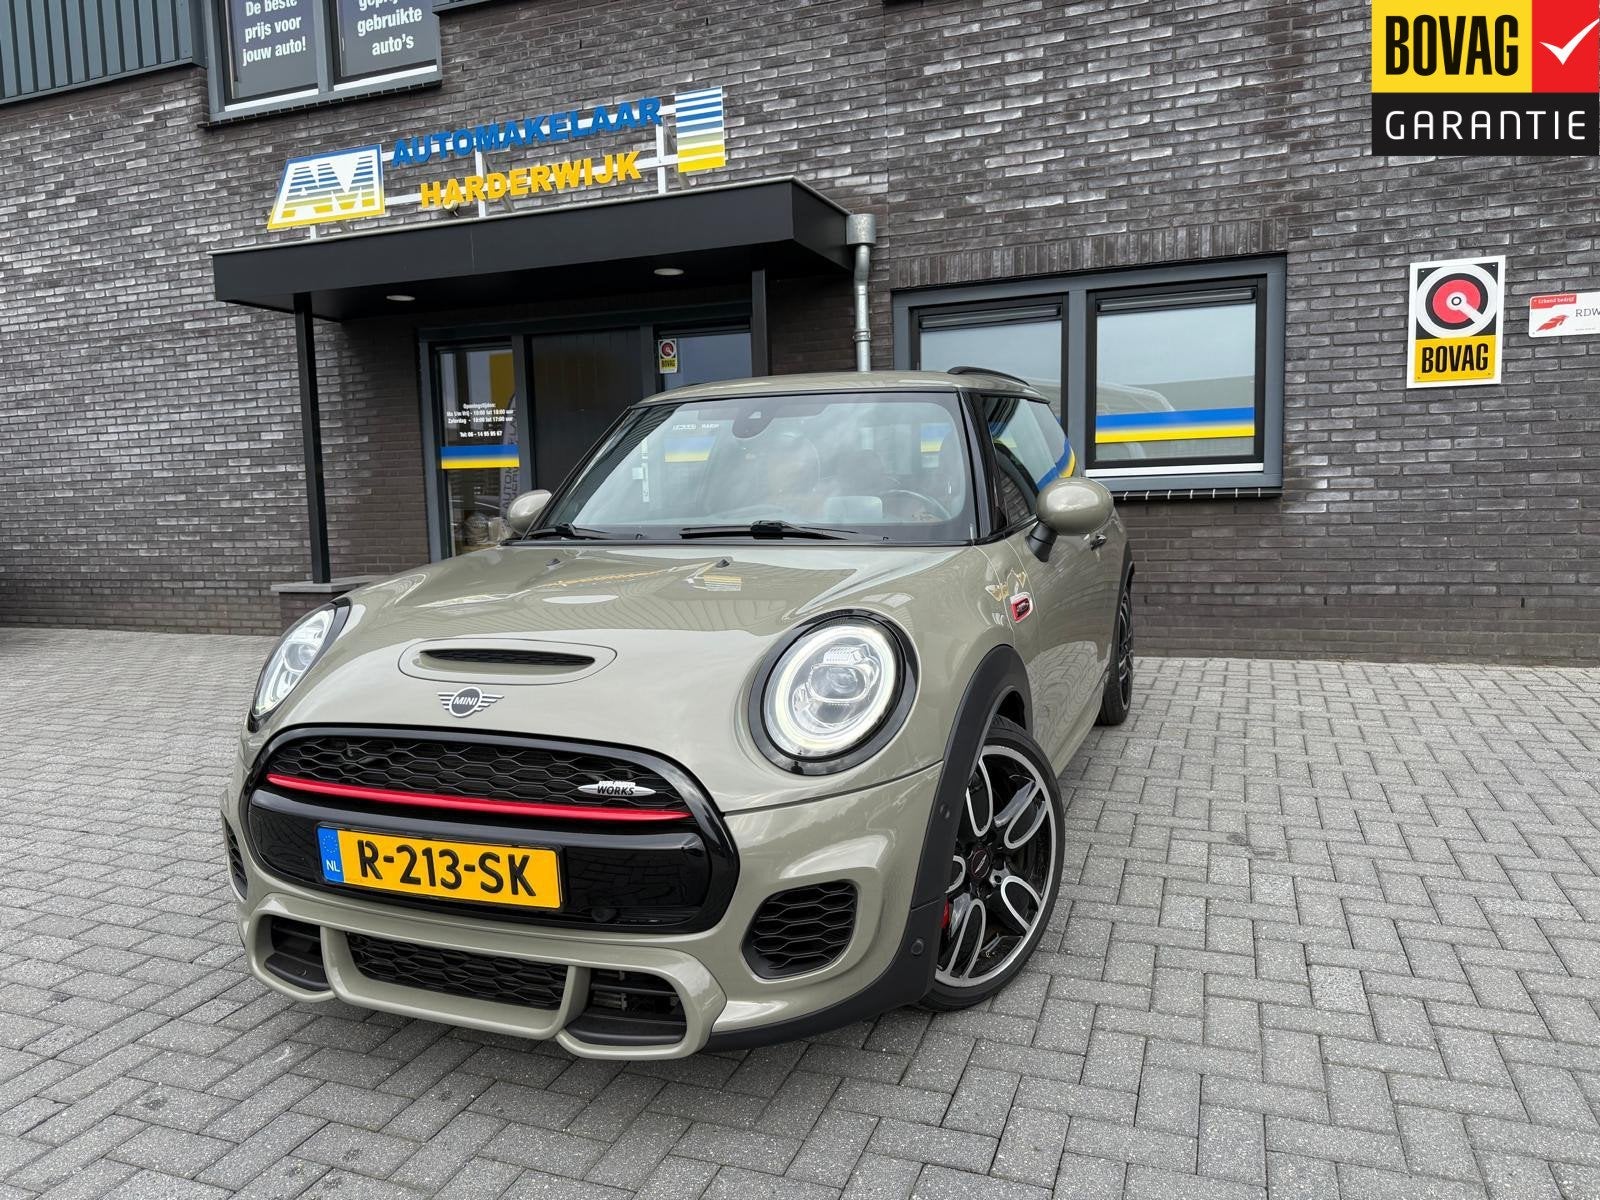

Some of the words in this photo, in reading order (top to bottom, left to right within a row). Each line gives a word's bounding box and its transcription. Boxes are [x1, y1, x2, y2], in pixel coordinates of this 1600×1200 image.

[246, 1, 261, 16] De
[357, 6, 423, 37] gebruikte
[245, 21, 272, 43] prijs
[274, 16, 302, 33] voor
[242, 46, 272, 67] jouw
[275, 35, 307, 57] auto!
[372, 33, 415, 56] auto's
[391, 96, 662, 168] AUTOMAKELAAR
[420, 151, 642, 208] HARDERWIJK
[1421, 343, 1490, 375] BOVAG
[453, 696, 478, 706] MINI
[597, 785, 635, 796] WORKS
[326, 859, 341, 873] NL
[357, 839, 537, 897] R-213-SK
